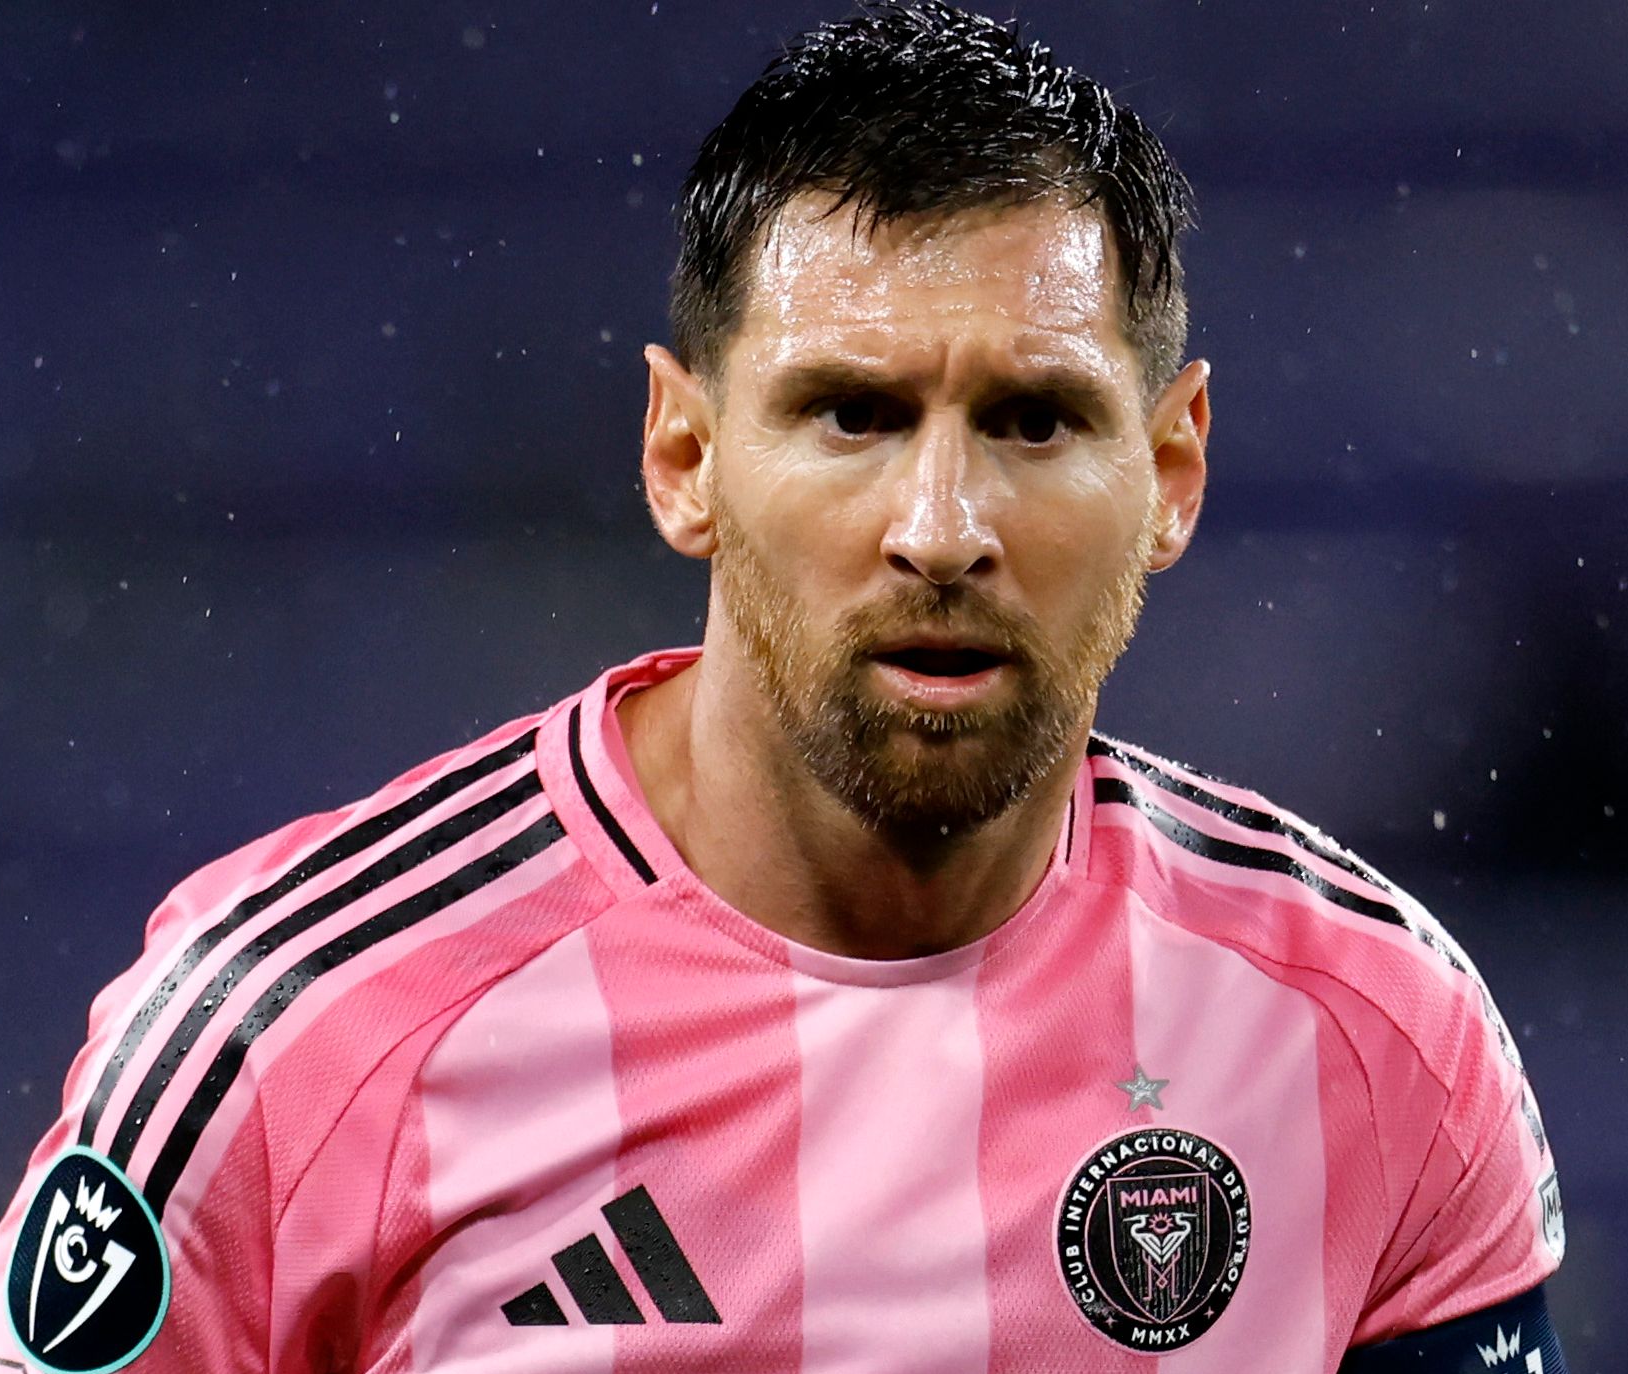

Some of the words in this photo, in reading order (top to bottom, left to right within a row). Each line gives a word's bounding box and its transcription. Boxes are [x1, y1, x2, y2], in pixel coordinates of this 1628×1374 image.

[1065, 1135, 1220, 1231] INTERNACIONAL
[1120, 1186, 1197, 1208] MIAMI
[1222, 1170, 1243, 1200] DE
[1066, 1244, 1095, 1303] CLUB
[1131, 1323, 1191, 1345] MMXX
